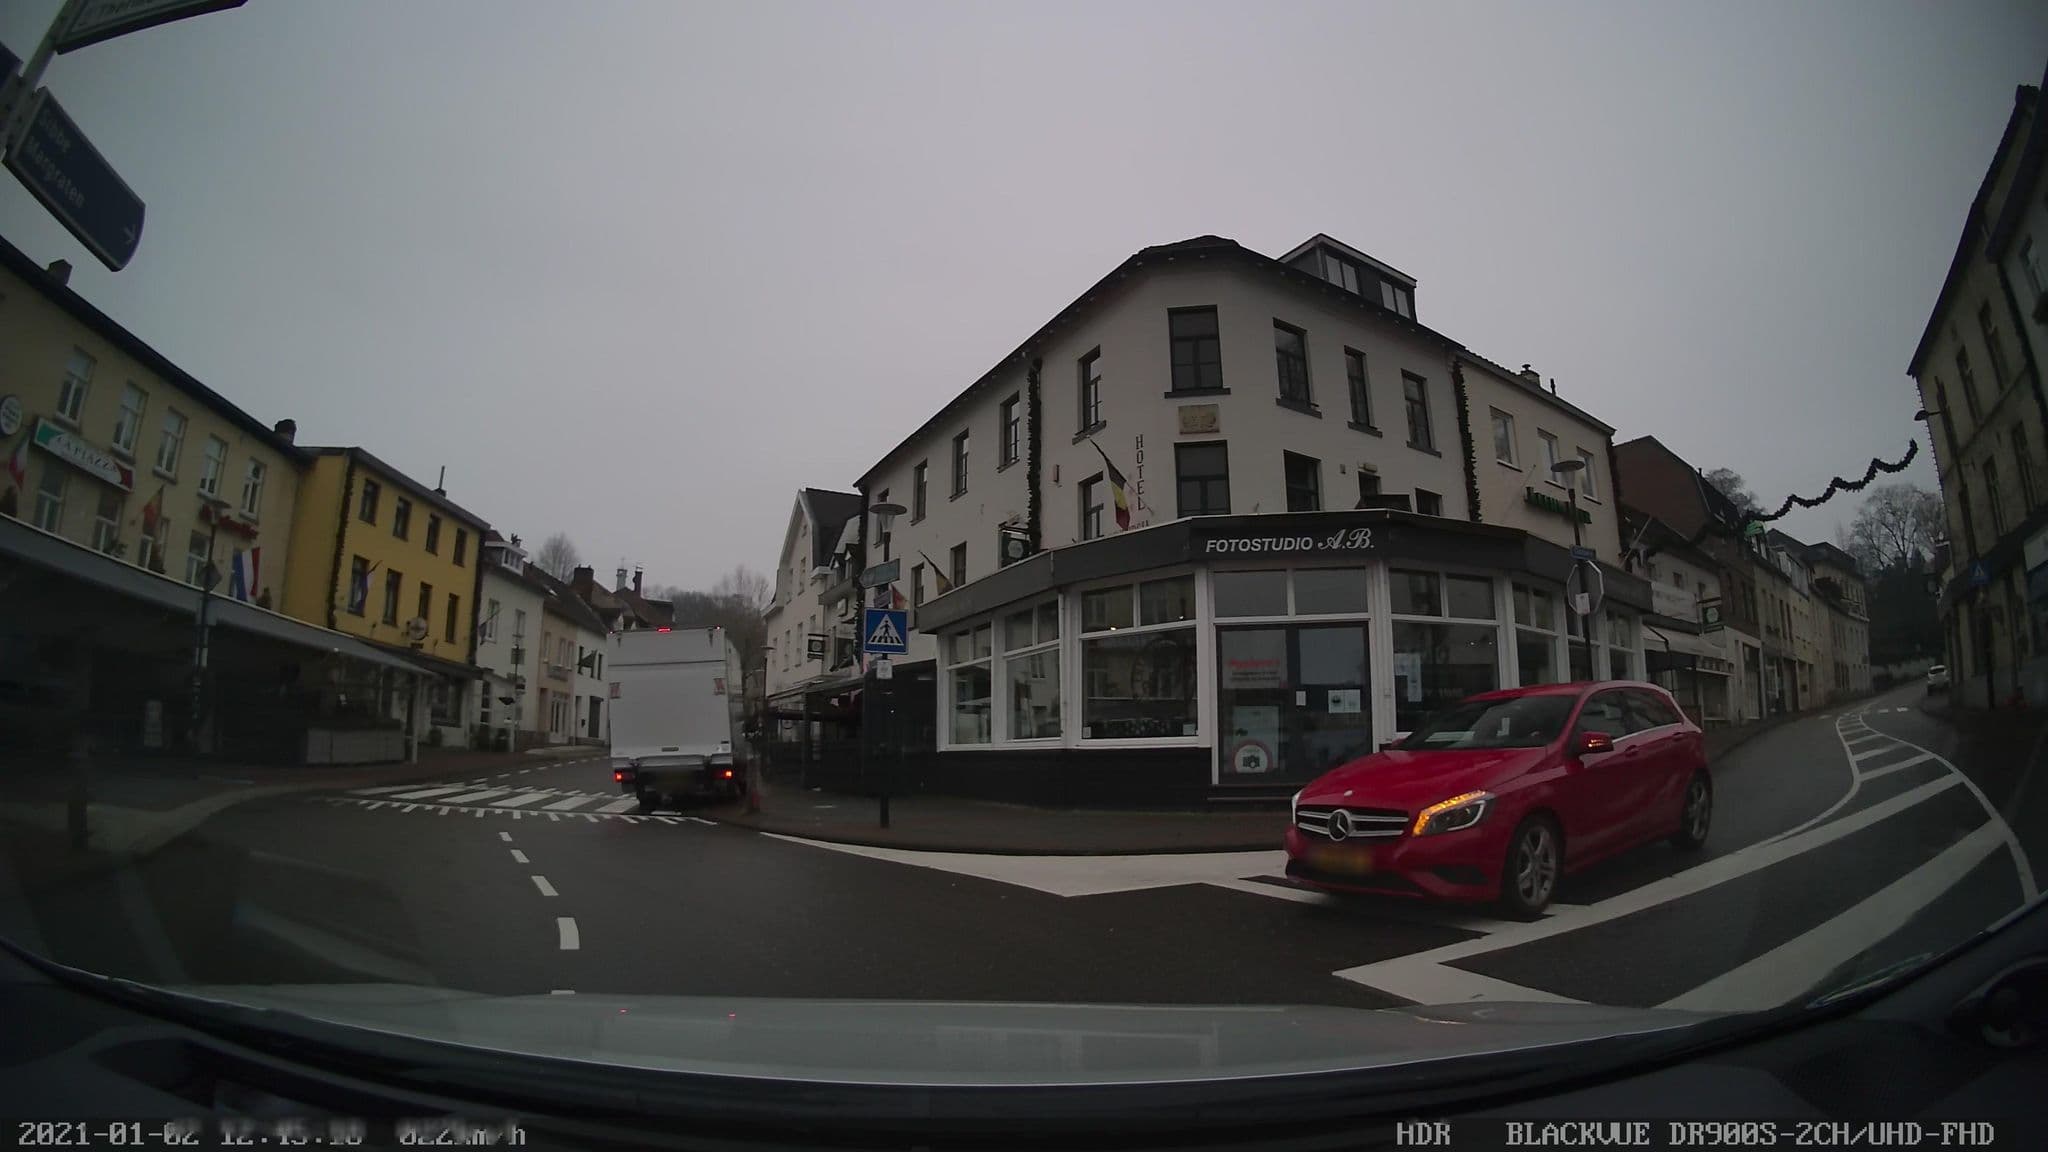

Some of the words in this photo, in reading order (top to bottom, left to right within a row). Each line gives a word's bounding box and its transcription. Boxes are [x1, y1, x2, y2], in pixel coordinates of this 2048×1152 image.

[26, 135, 87, 209] Margraten
[1135, 433, 1146, 512] HOTEL
[1205, 536, 1314, 553] FOTOSTUDIO
[1317, 527, 1376, 551] A.B.
